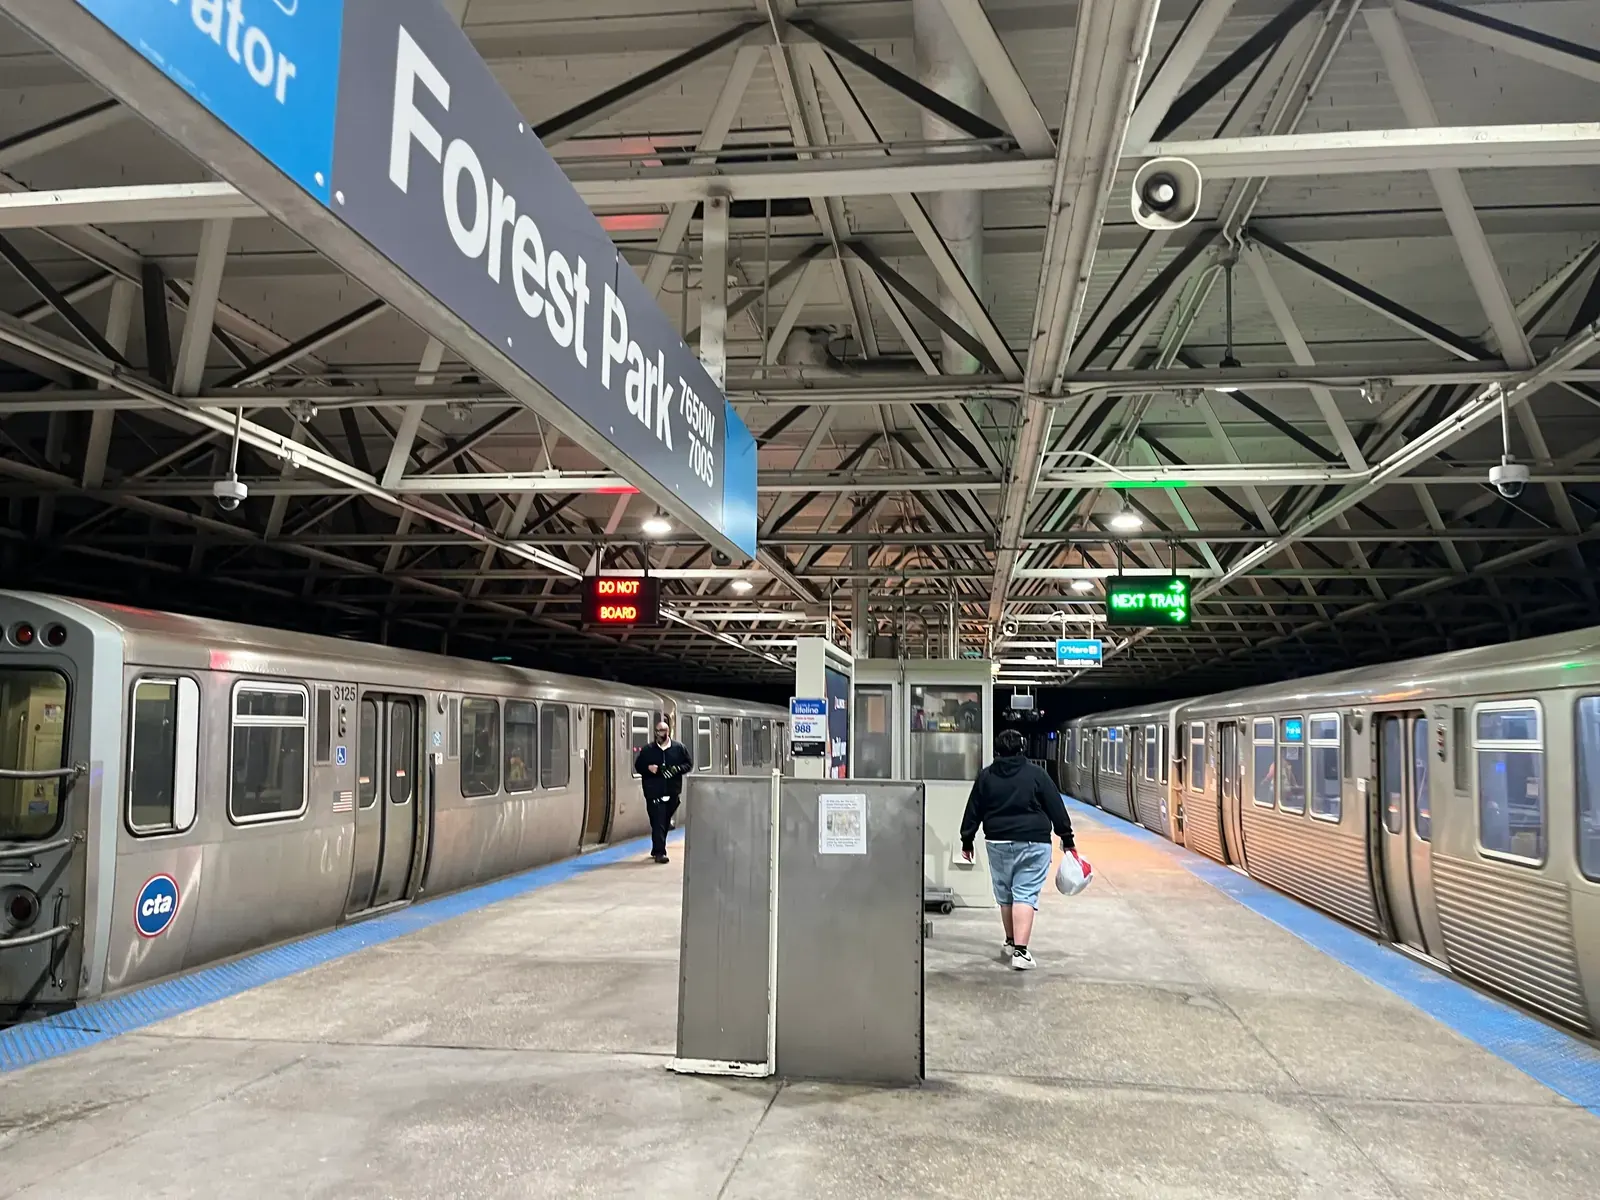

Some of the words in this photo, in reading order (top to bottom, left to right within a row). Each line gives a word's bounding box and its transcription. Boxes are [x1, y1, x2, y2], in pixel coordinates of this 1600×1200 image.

[168, 0, 297, 105] ator
[389, 24, 590, 369] Forest
[601, 282, 674, 452] Park
[679, 375, 716, 448] 7650W
[688, 430, 714, 488] 700S
[598, 581, 615, 594] DO
[616, 581, 640, 594] NOT
[1111, 593, 1146, 608] NEXT
[1149, 593, 1185, 608] TRAIN
[600, 606, 637, 619] BOARD
[1060, 645, 1089, 654] O'Hare
[334, 685, 356, 701] 3125
[795, 705, 819, 714] lifeline
[794, 725, 811, 733] 988
[142, 893, 173, 917] cta
